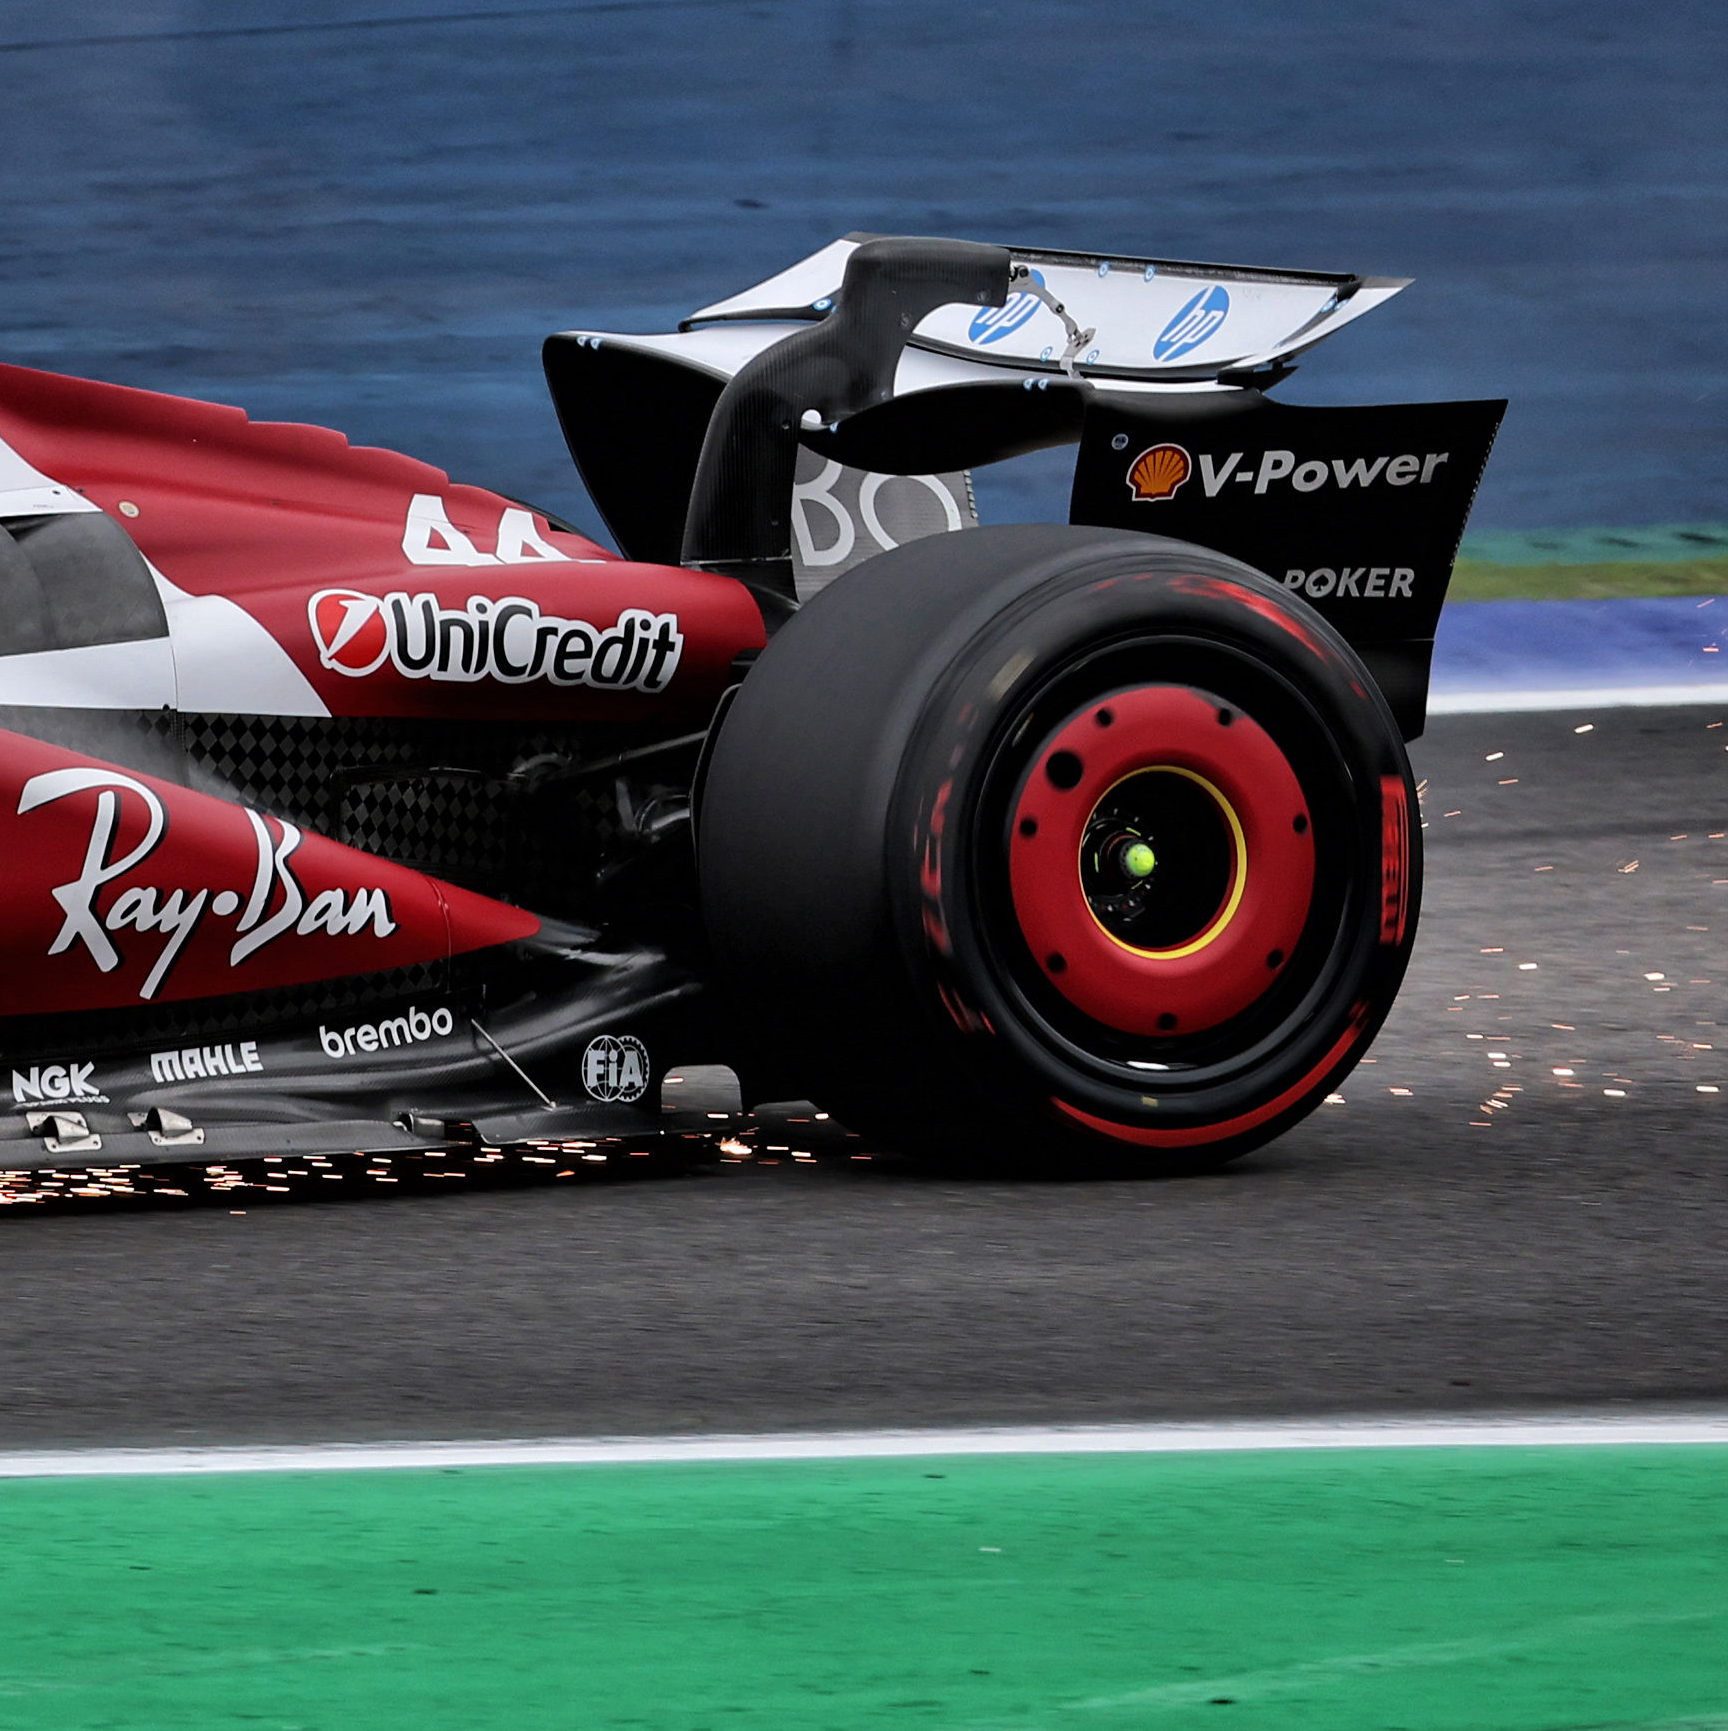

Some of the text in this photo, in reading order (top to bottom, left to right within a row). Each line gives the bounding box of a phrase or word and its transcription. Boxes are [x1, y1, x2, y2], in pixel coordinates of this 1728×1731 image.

[1157, 285, 1229, 362] hp
[1198, 449, 1449, 498] V-Power
[1283, 567, 1416, 599] POKER
[388, 593, 679, 691] UniCredit
[319, 1006, 454, 1059] brembo
[11, 1060, 100, 1103] NGK
[150, 1040, 264, 1084] MAHLE
